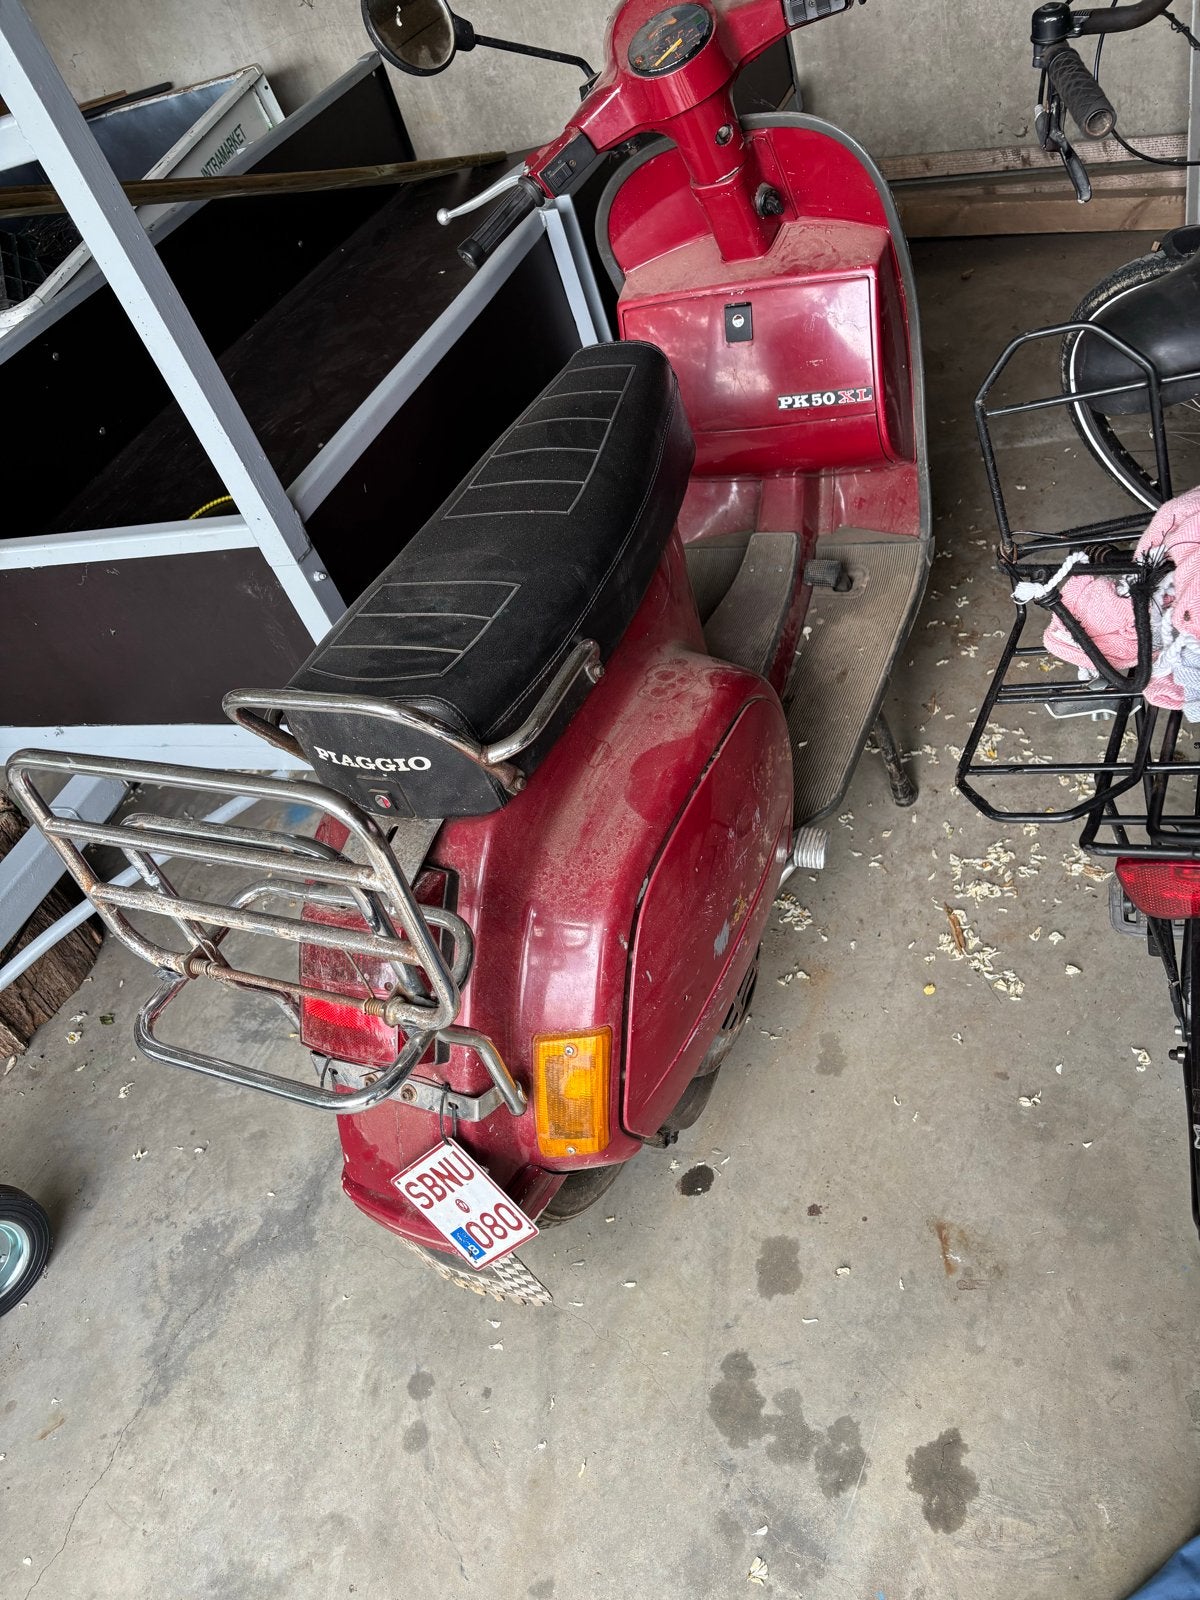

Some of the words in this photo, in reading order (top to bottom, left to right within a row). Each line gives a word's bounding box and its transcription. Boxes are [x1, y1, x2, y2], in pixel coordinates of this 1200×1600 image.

[313, 745, 432, 772] PIAGGIO
[404, 1150, 475, 1210] SBNU
[465, 1202, 523, 1249] 080
